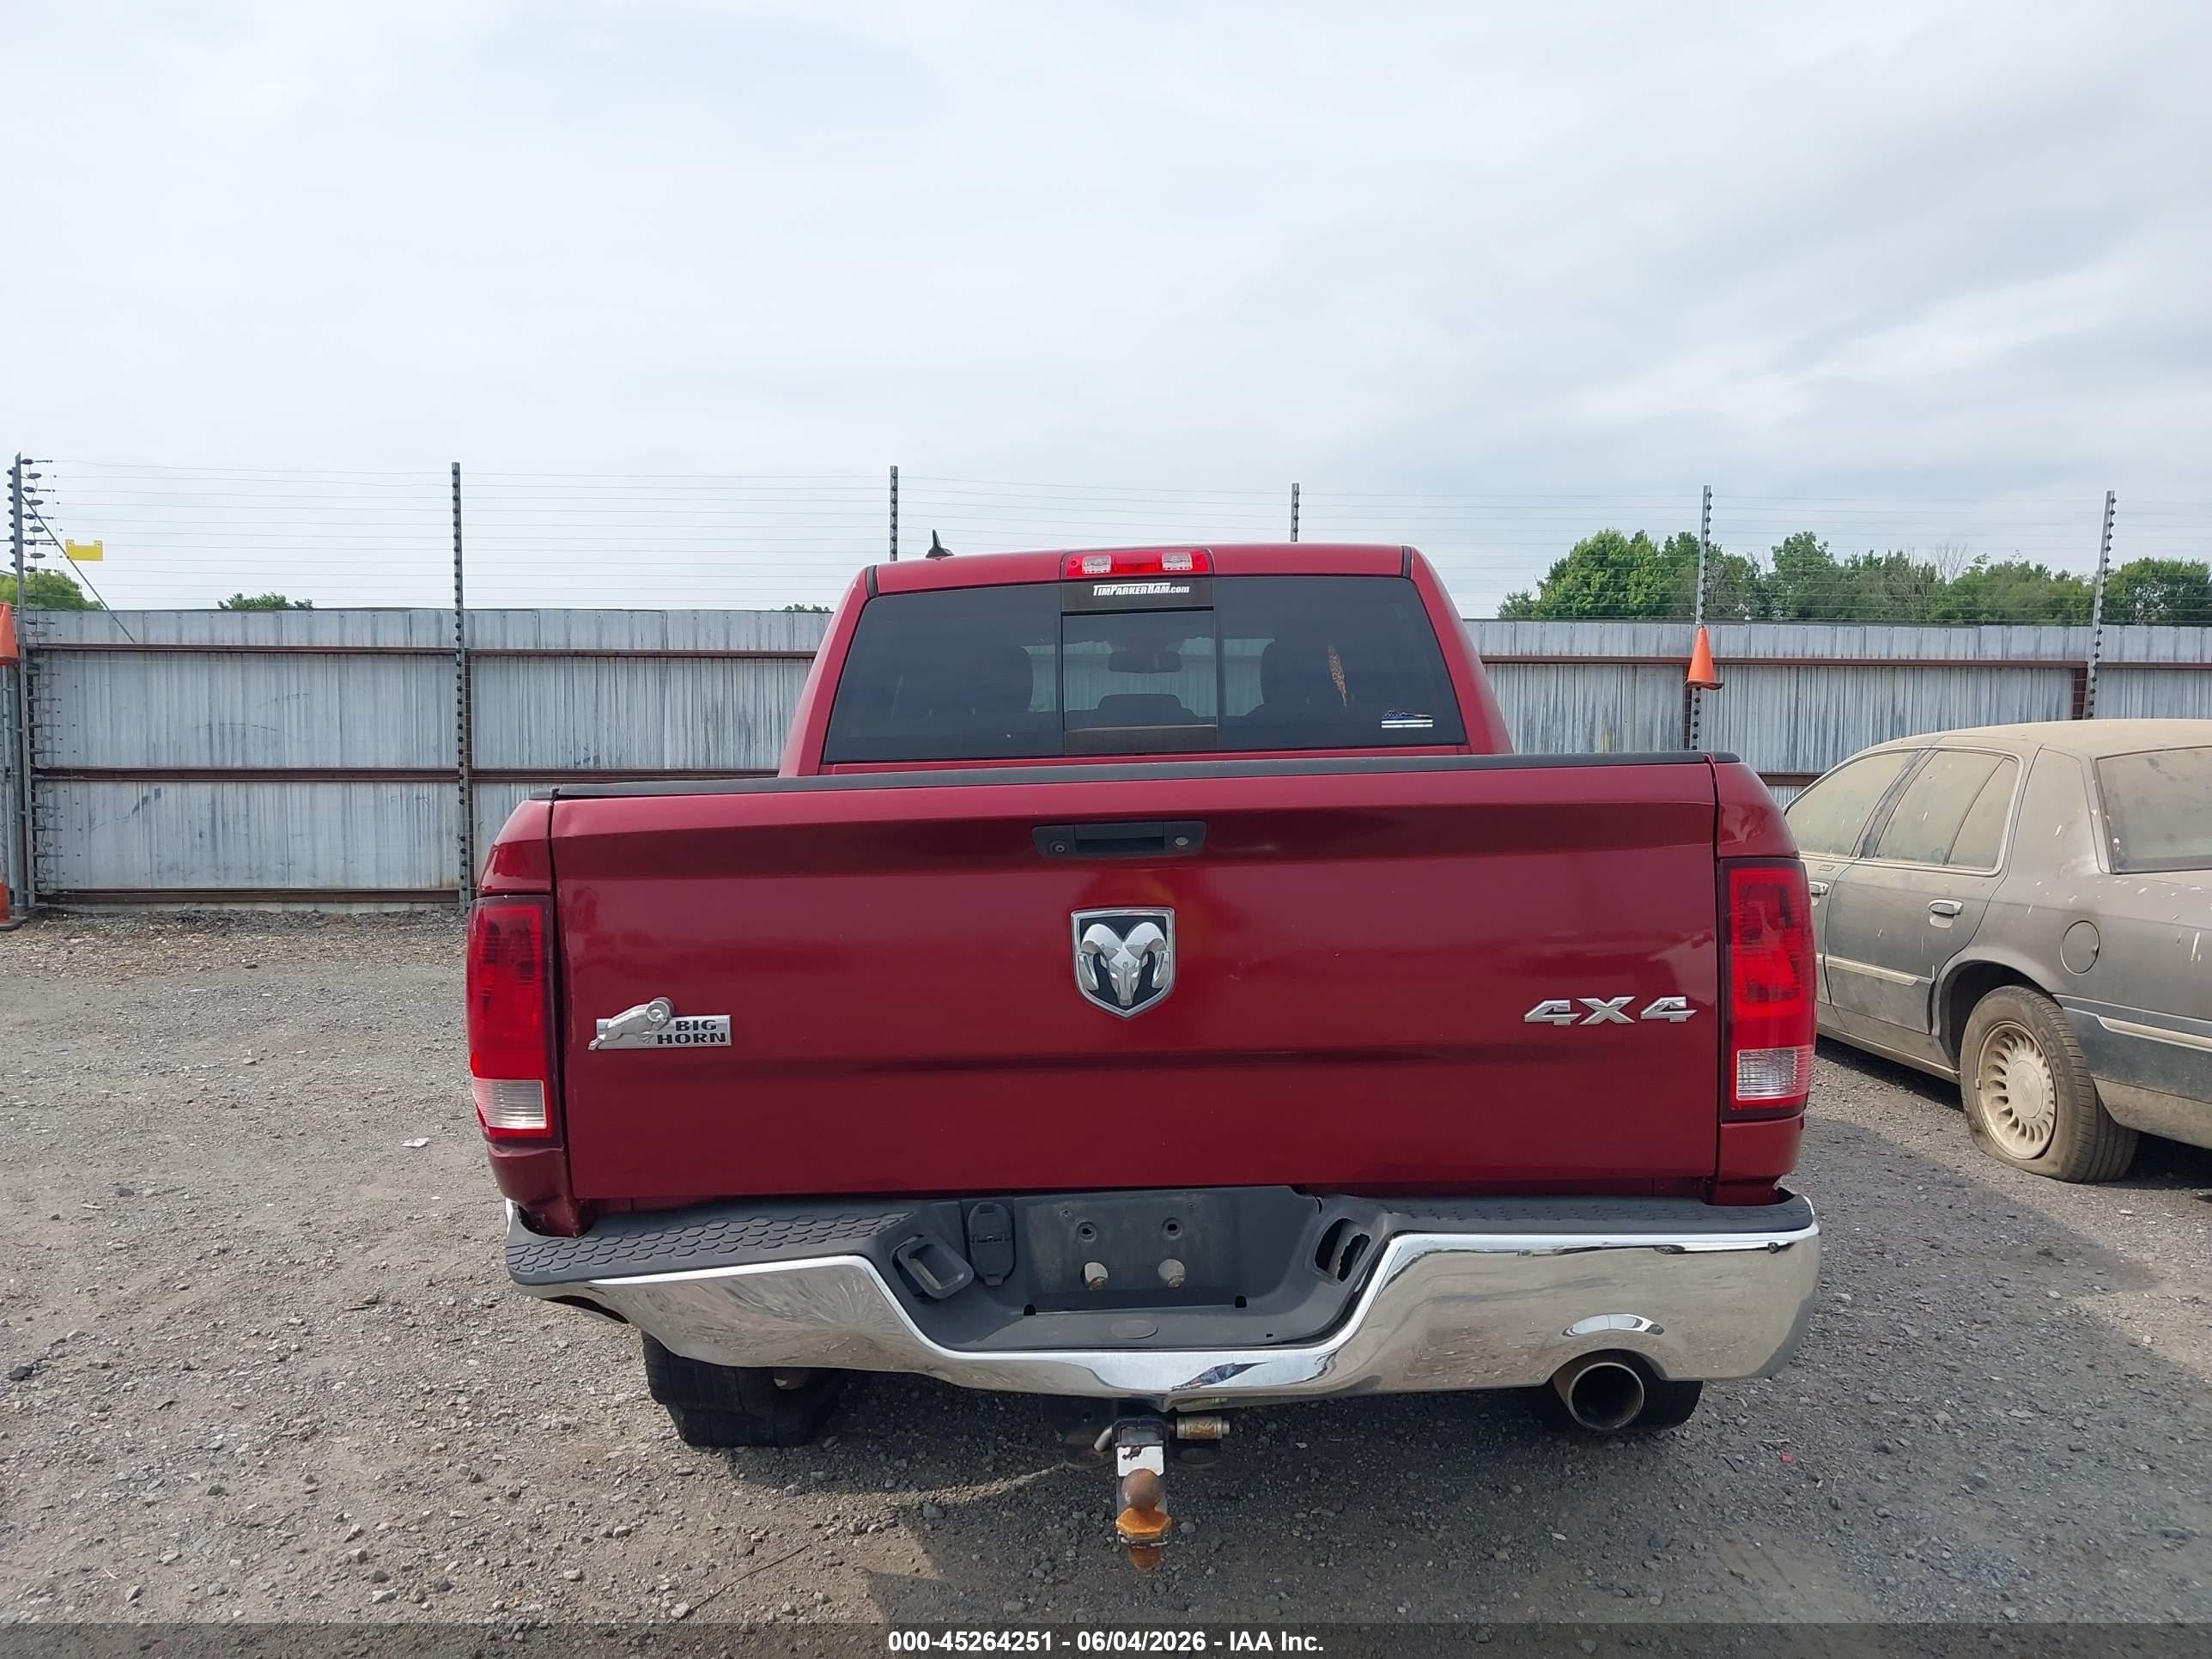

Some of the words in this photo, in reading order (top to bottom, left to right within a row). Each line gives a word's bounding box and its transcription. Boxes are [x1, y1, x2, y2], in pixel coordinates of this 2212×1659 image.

[1524, 996, 1698, 1026] 4X4
[675, 1019, 717, 1031] BIG
[656, 1032, 726, 1045] HORN
